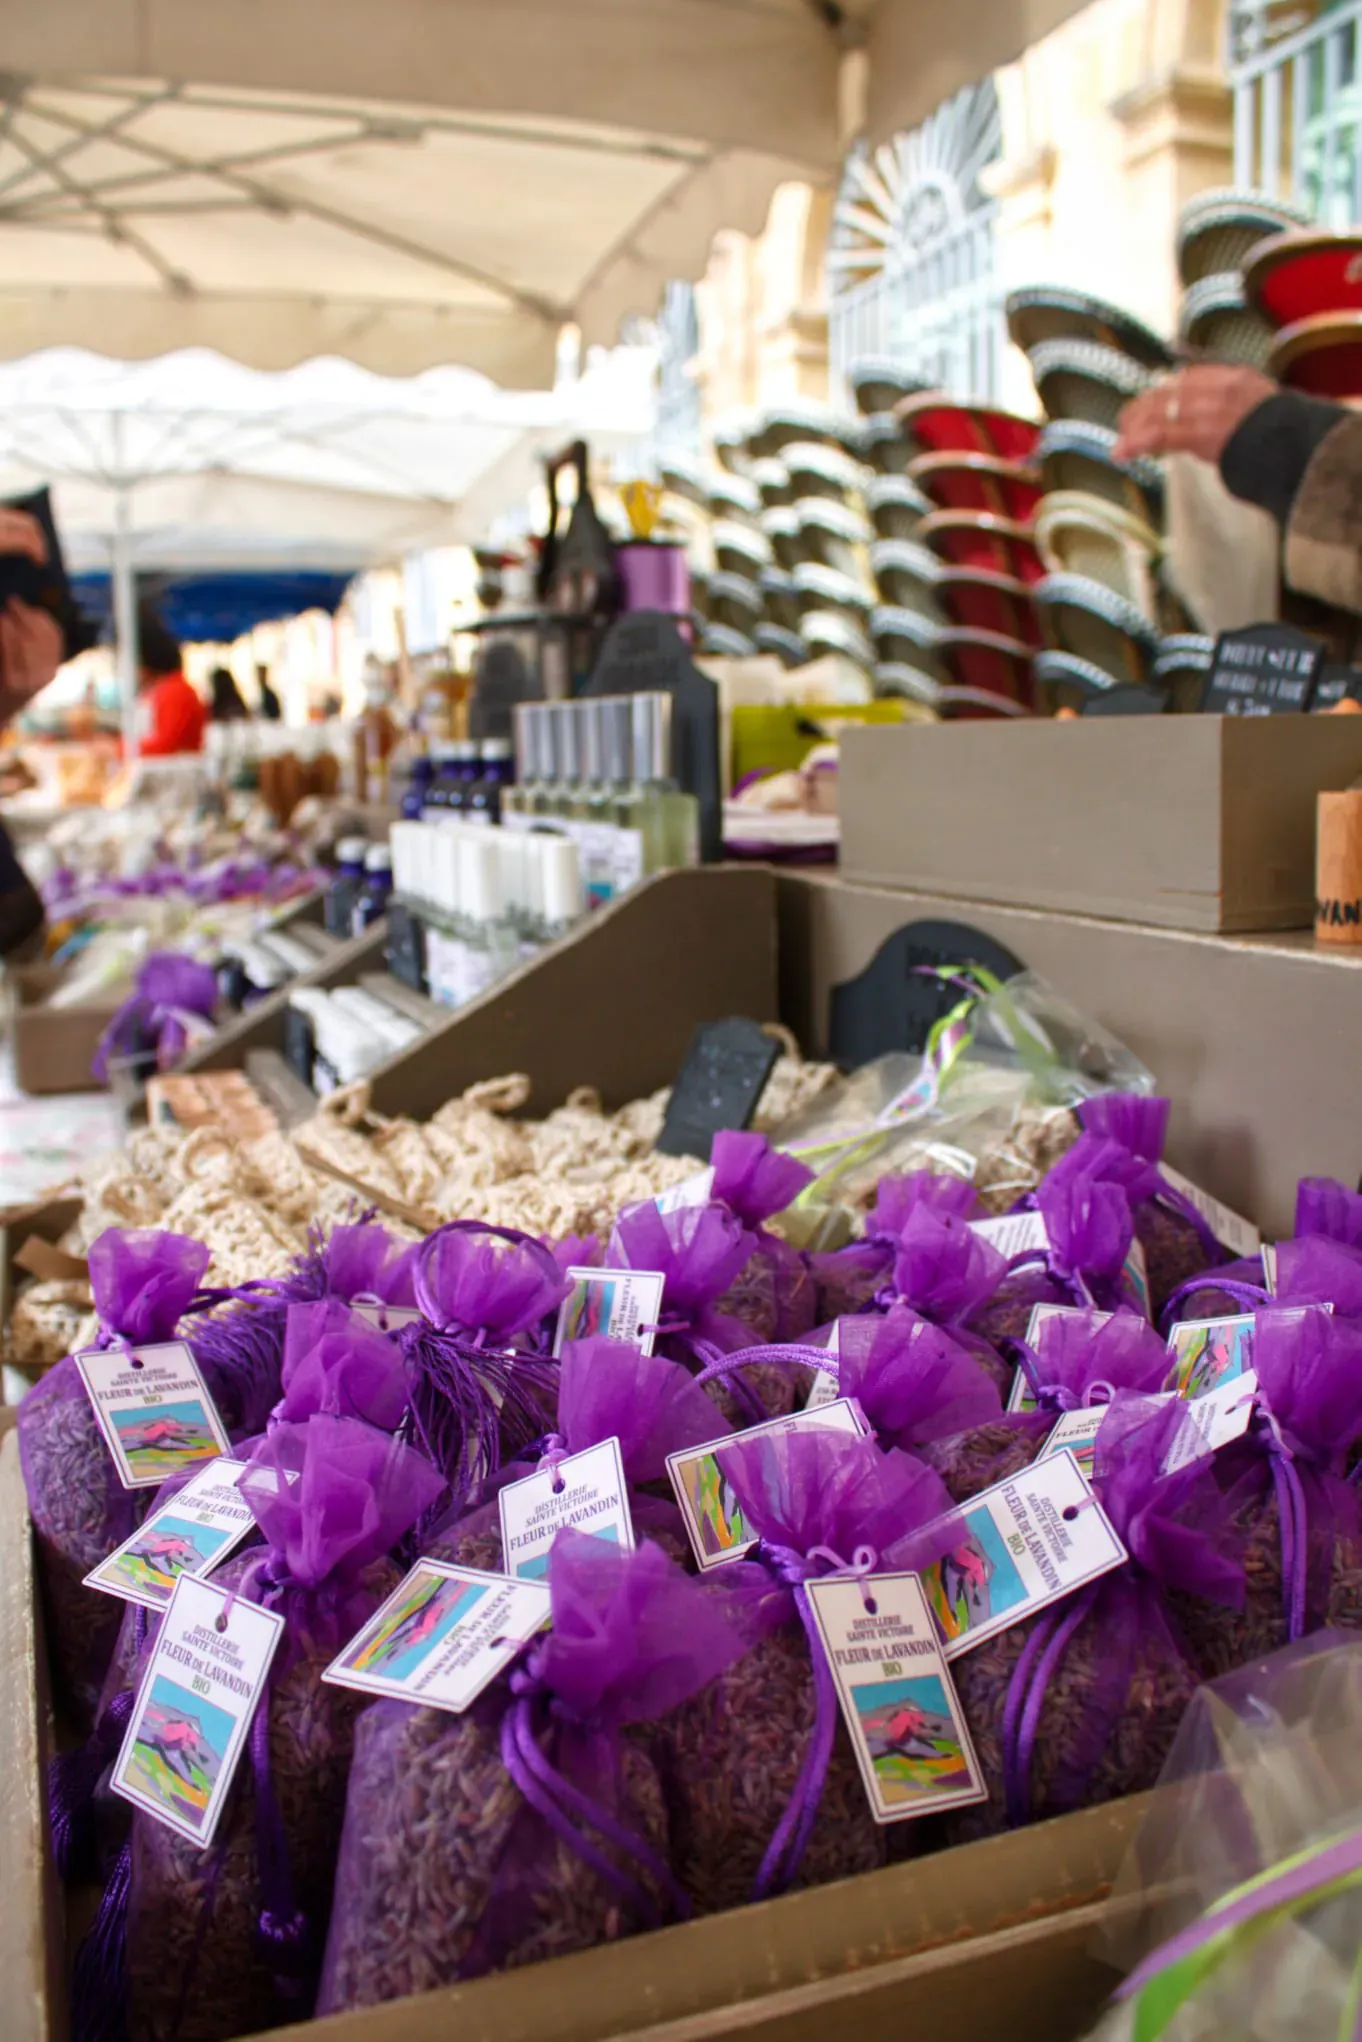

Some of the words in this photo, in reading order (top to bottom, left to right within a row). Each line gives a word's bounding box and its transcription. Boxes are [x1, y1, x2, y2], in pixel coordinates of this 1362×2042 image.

[97, 1387, 133, 1400] FLEUR
[146, 1380, 199, 1395] LAVANDIN
[525, 1507, 557, 1527] SAINTE
[559, 1489, 598, 1513] VICTOIRE
[535, 1484, 587, 1514] DISTILLERIE
[1001, 1484, 1028, 1522] FLEUR
[509, 1526, 547, 1551] FLEUR
[547, 1521, 560, 1535] DE
[561, 1494, 619, 1528] LAVANDIN
[1017, 1520, 1032, 1535] DE
[1026, 1493, 1048, 1525] SAINTE
[1042, 1523, 1068, 1564] VICTOIRE
[1040, 1497, 1073, 1548] DISTILLERIE
[1007, 1533, 1026, 1555] BIO
[1024, 1532, 1062, 1590] LAVANDIN
[846, 1629, 877, 1642] SAINTE
[879, 1624, 915, 1639] VICTOIRE
[852, 1614, 901, 1630] DISTILLERIE
[182, 1630, 209, 1652] SAINTE
[209, 1645, 244, 1671] VICTOIRE
[193, 1624, 240, 1655] DISTILLERIE
[834, 1646, 872, 1666] FLEUR
[871, 1647, 883, 1661] DE
[883, 1639, 936, 1660] LAVANDIN
[160, 1639, 193, 1667] FLEUR
[204, 1661, 253, 1699] LAVANDIN
[881, 1661, 903, 1677] BIO
[191, 1674, 211, 1695] BIO
